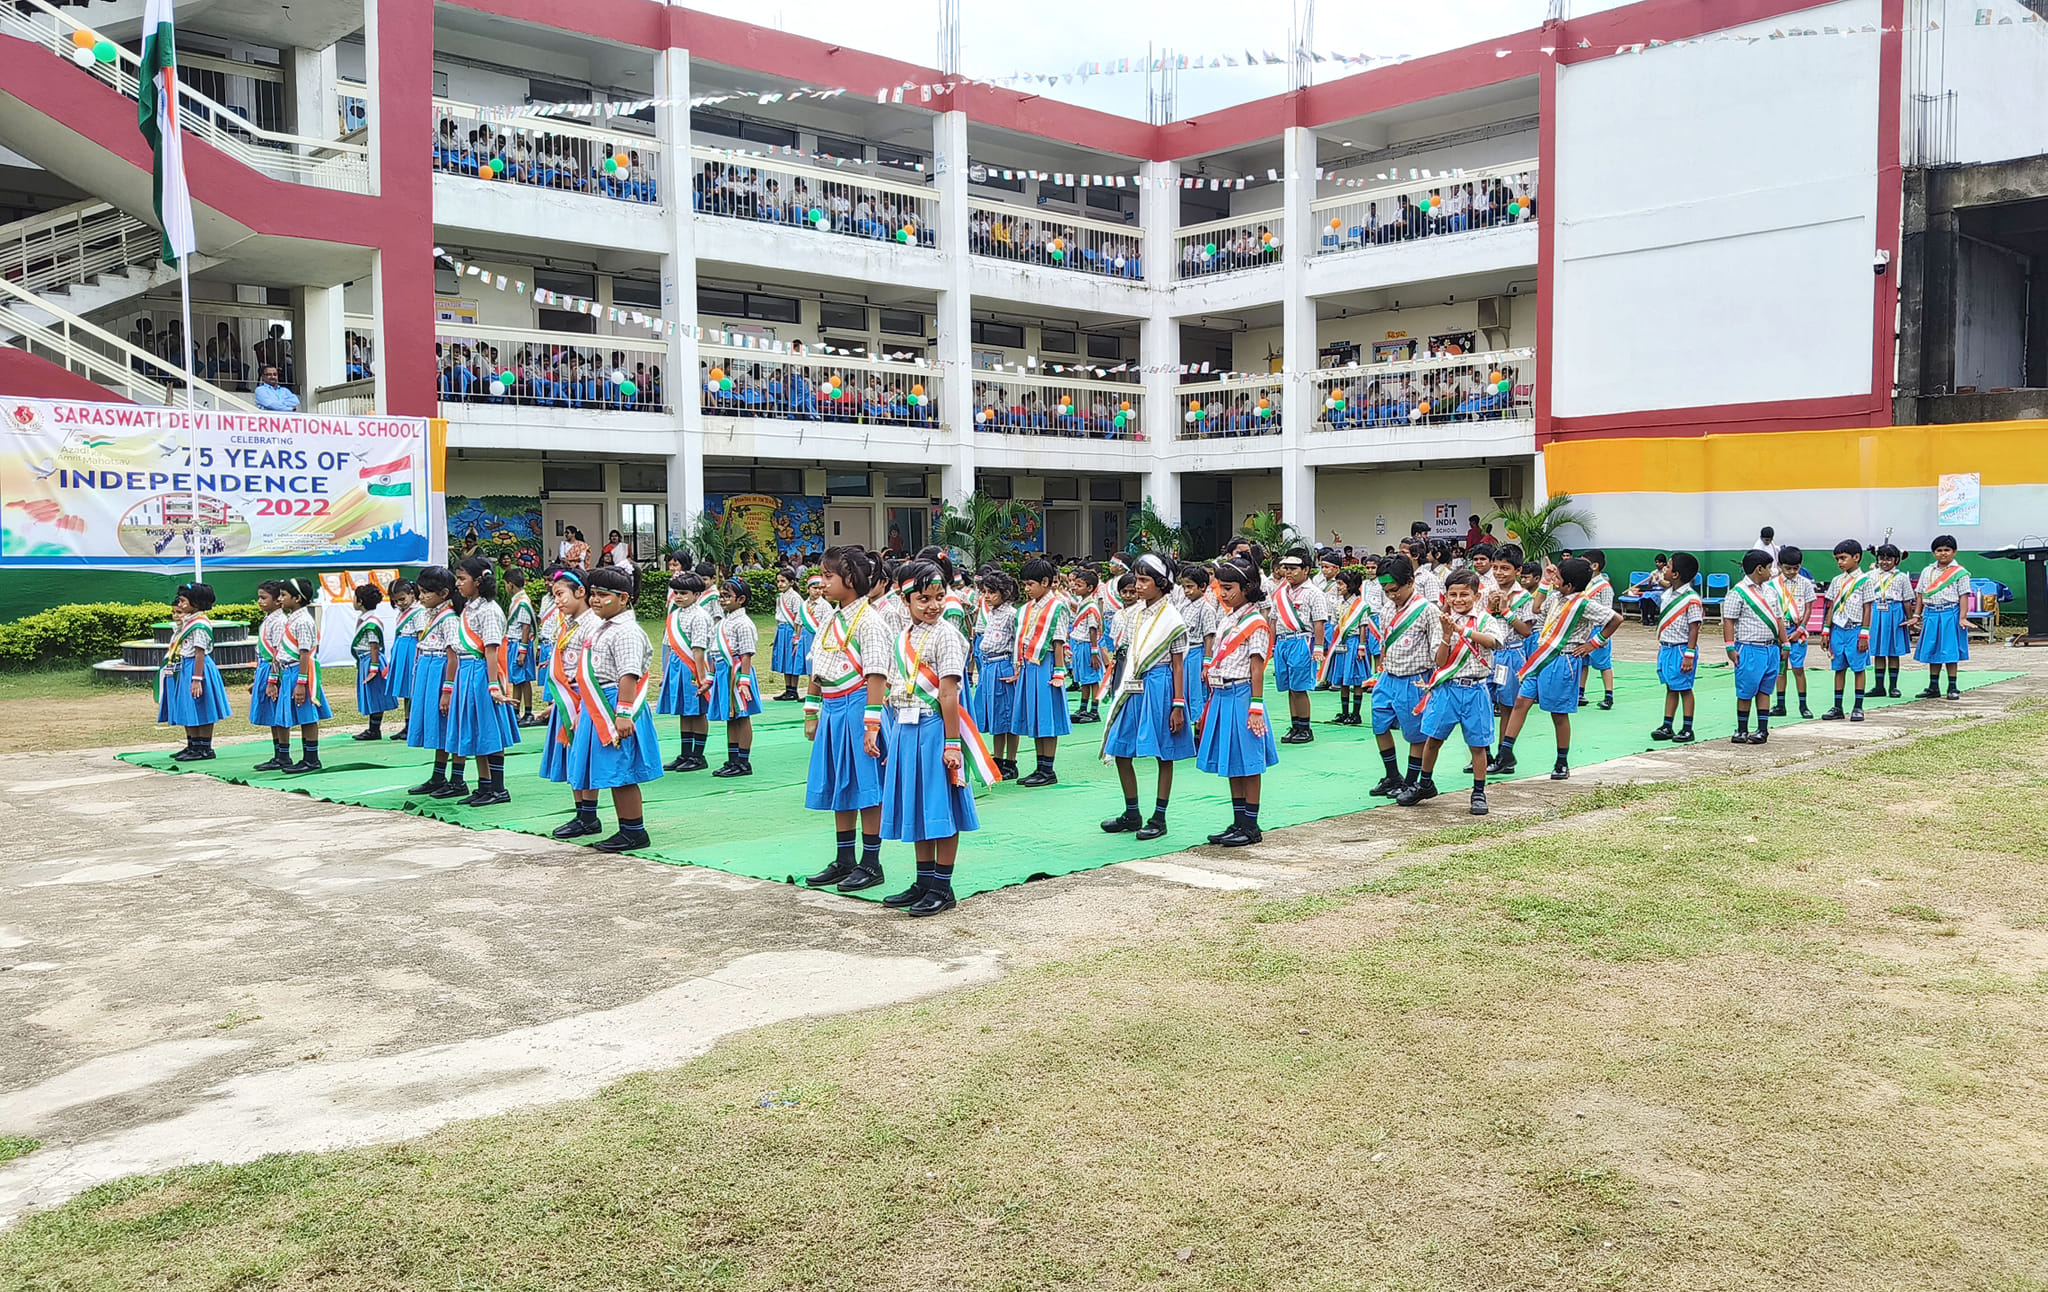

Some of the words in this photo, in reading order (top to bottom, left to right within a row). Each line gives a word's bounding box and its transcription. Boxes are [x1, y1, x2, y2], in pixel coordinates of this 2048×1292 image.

[54, 406, 161, 428] SARASWATI
[169, 412, 210, 430] DEVI
[217, 415, 353, 436] INTERNATIONAL
[358, 421, 420, 438] SCHOOL
[230, 435, 294, 446] CELEBRATING
[182, 446, 214, 468] 75
[224, 448, 307, 470] YEARS
[317, 451, 351, 471] OF
[60, 469, 329, 493] INDEPENDENCE
[255, 498, 332, 517] 2022
[1435, 518, 1458, 526] INDIA
